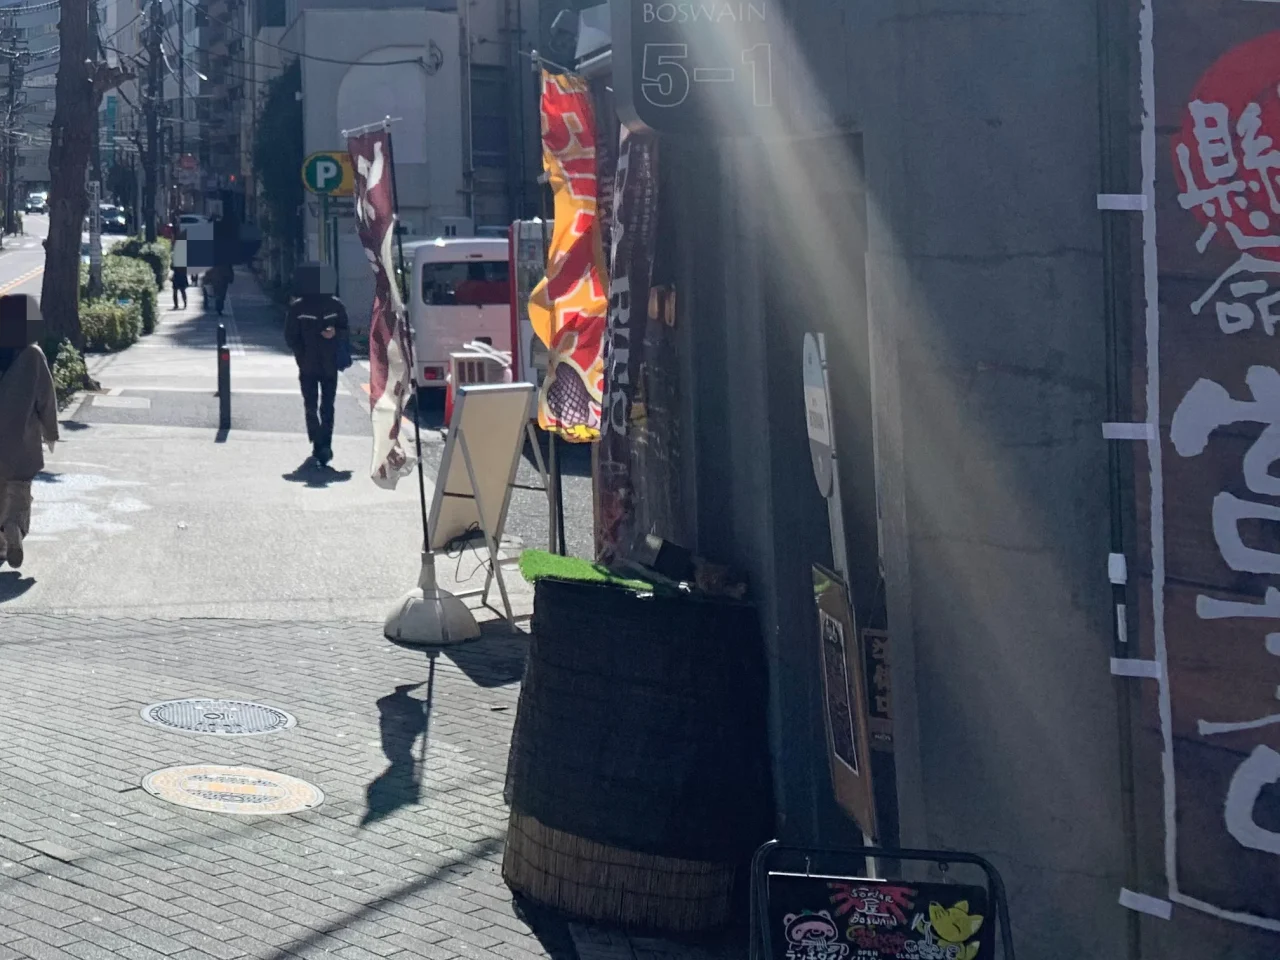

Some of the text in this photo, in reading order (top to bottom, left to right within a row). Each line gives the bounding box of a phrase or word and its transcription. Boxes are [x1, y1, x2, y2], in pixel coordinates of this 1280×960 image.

[643, 2, 766, 23] BOSWAIN
[641, 43, 772, 107] 5-1
[316, 161, 337, 189] P
